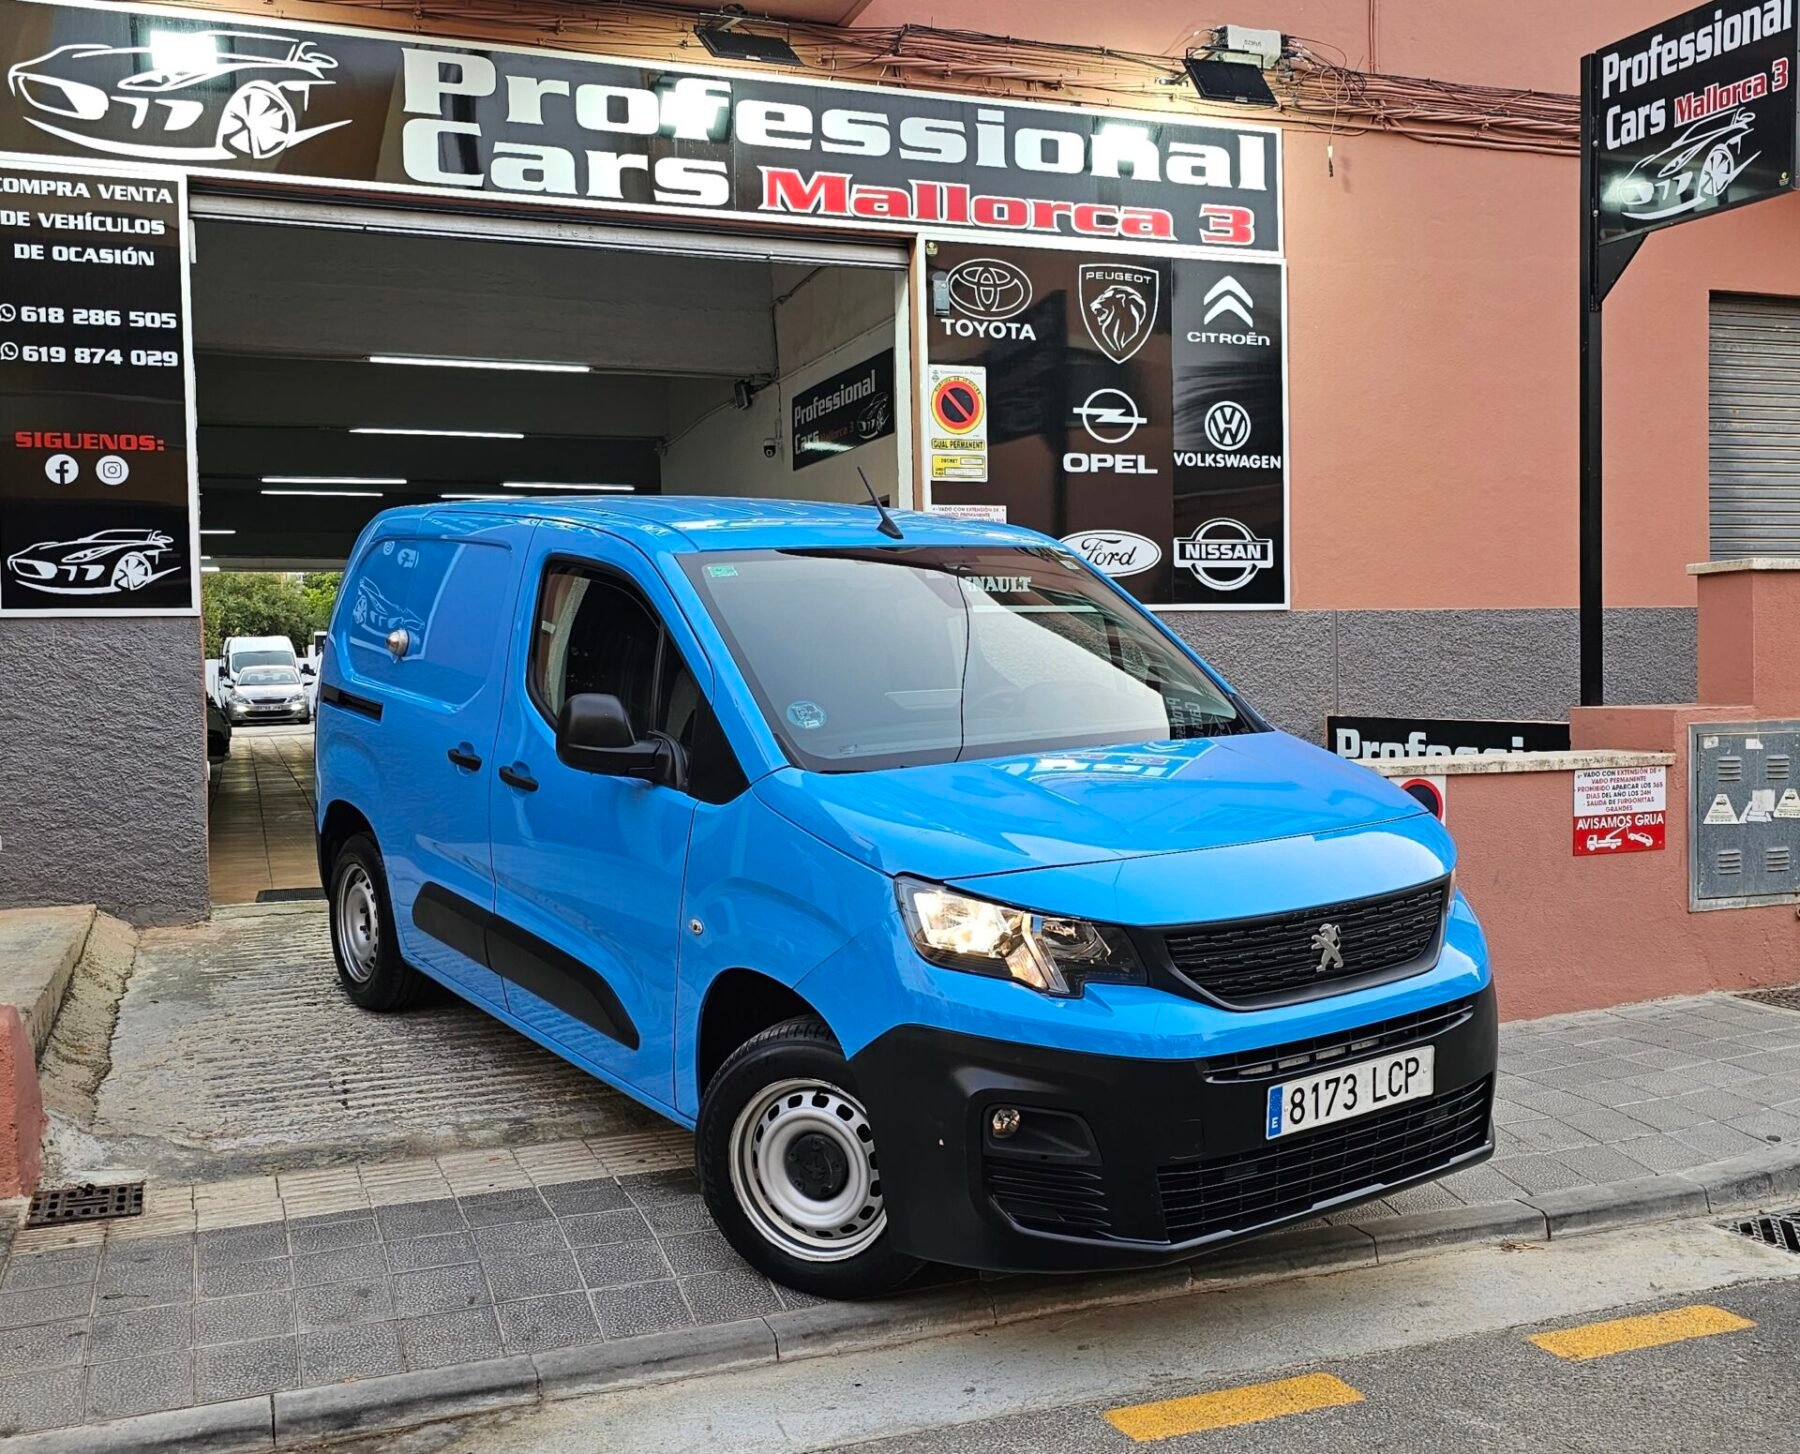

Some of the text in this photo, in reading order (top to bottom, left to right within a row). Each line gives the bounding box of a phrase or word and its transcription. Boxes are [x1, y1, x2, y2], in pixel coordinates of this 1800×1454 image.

[1603, 0, 1792, 99] Professional
[1606, 57, 1789, 150] Cars Mallorca 3
[402, 47, 1268, 191] Professional
[0, 176, 174, 204] OMPRA VENTA
[402, 118, 1256, 247] Cars Mallorca 3
[1, 210, 165, 235] DE VEHÍCULOS
[14, 243, 155, 266] DE OCASIÓN
[1085, 271, 1152, 285] PEUGEOT
[20, 306, 177, 328] 618 286 505
[941, 318, 1036, 341] TOYOTA
[22, 346, 178, 367] 619 874 029
[794, 369, 876, 428] Professional
[15, 431, 165, 451] SIGUENOS:
[1063, 453, 1158, 474] OPEL
[1174, 452, 1281, 469] VOLKSWAGEN
[1081, 538, 1136, 566] Ford
[1185, 544, 1261, 559] NISSAN
[1576, 813, 1664, 830] AVISAMOS GRUA
[1290, 1056, 1419, 1125] 8173 LCP
[1272, 1117, 1278, 1128] E
